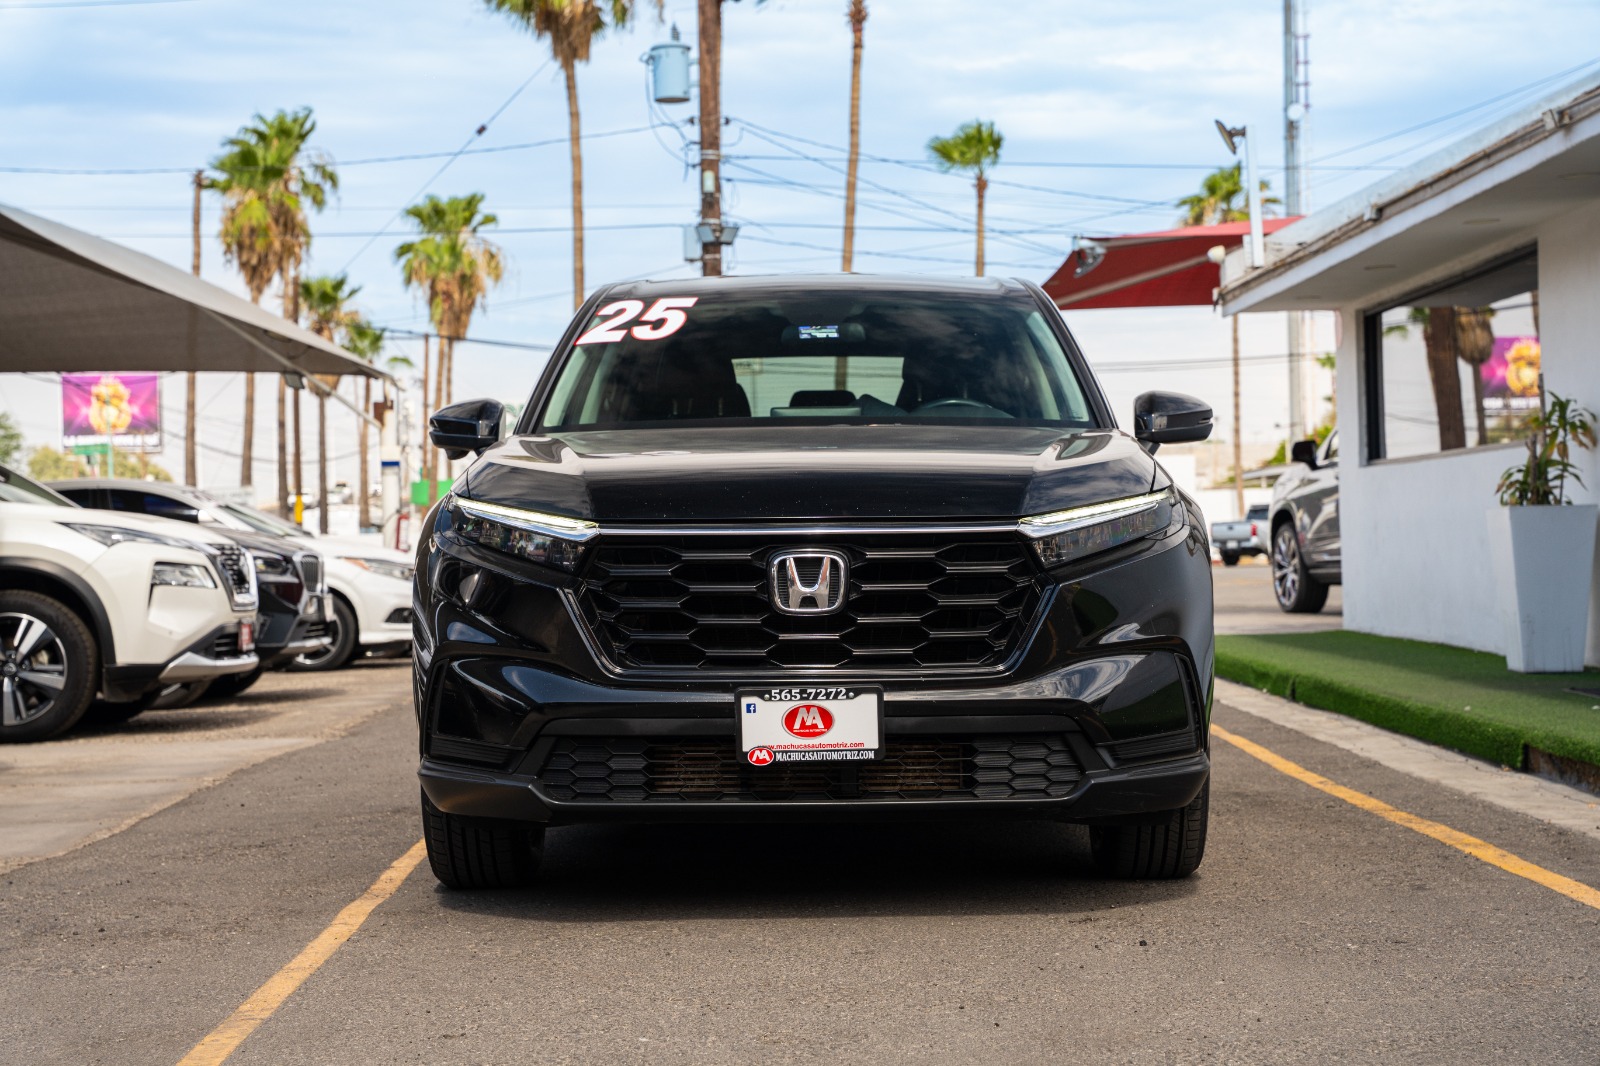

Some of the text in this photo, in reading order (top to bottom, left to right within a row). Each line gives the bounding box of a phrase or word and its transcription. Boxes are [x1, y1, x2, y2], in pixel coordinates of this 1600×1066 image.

[573, 296, 699, 346] 25
[771, 688, 847, 700] 565-7272
[762, 742, 865, 750] w.machucasautomotriz.com
[775, 750, 875, 762] MACHUCASAUTOMOTRIZ.COM
